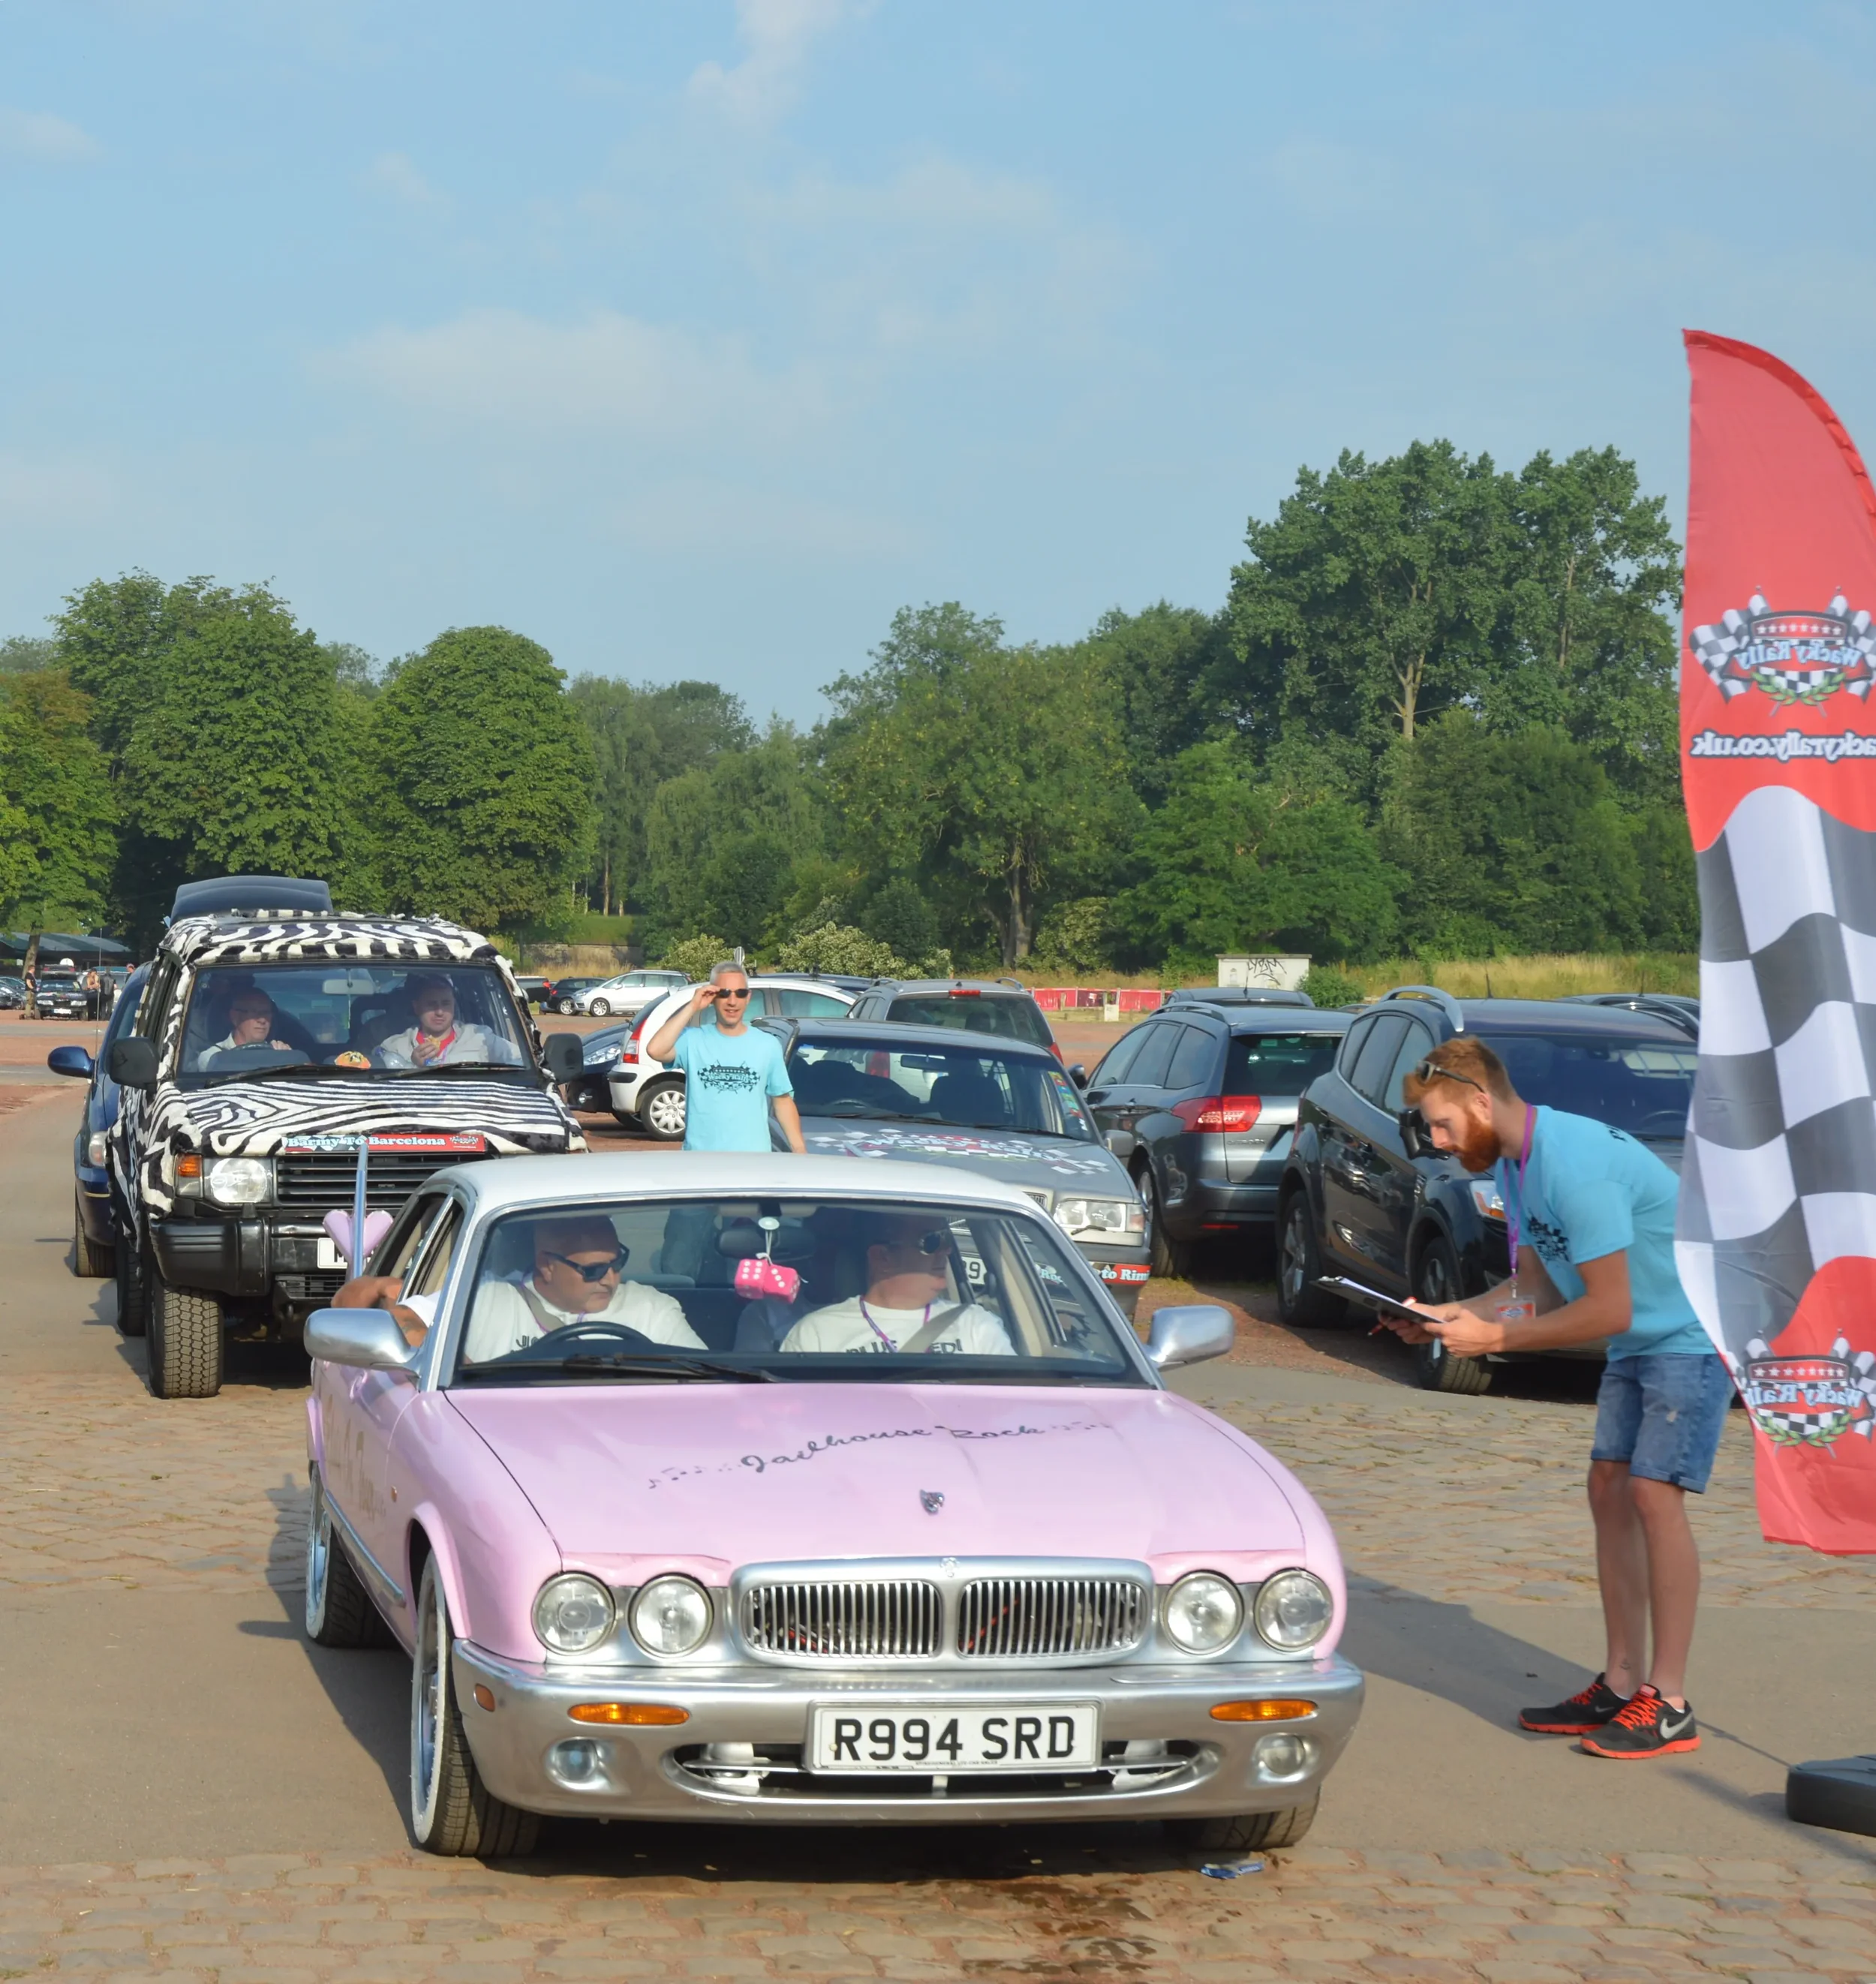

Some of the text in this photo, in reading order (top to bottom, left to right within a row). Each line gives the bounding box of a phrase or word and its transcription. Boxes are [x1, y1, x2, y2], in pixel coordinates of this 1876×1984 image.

[288, 1137, 340, 1150] Barmy
[345, 1138, 366, 1146] To
[368, 1136, 446, 1146] Barcelona
[1101, 1269, 1117, 1279] to
[740, 1425, 1046, 1473] Jailhouse Rock
[834, 1716, 1075, 1760] R994 SRD
